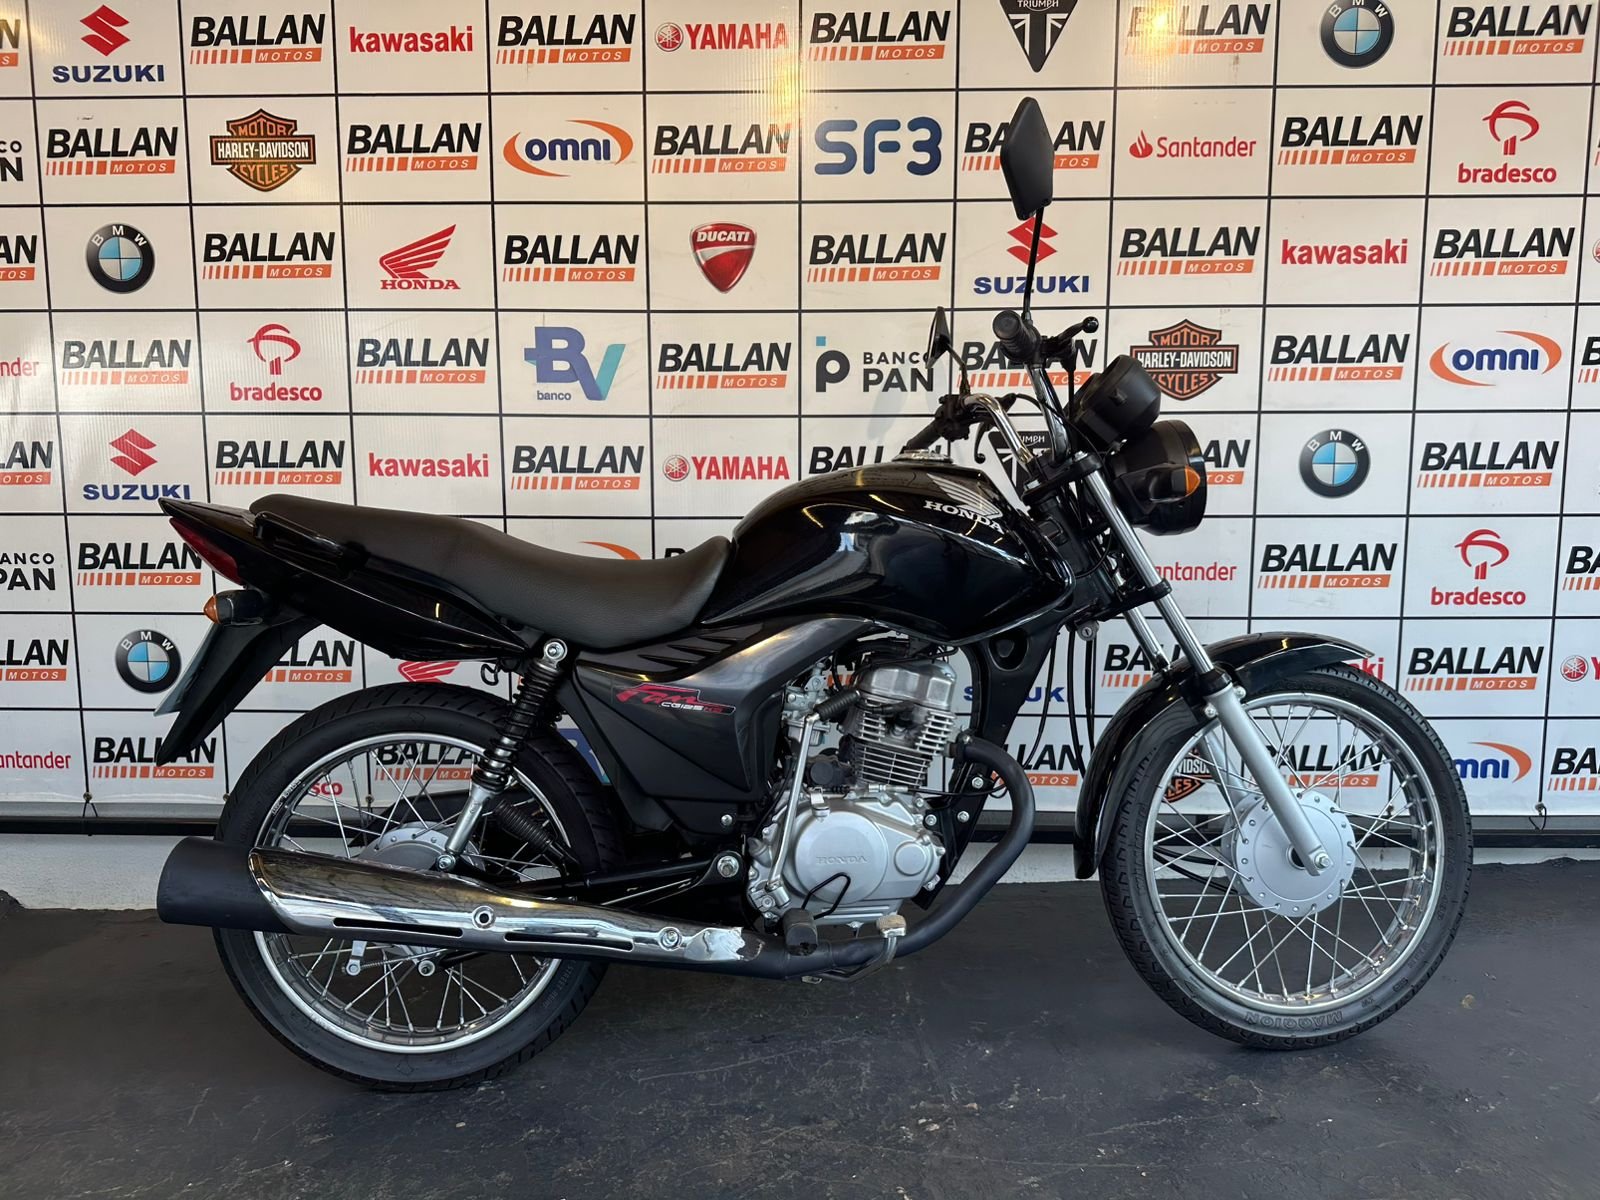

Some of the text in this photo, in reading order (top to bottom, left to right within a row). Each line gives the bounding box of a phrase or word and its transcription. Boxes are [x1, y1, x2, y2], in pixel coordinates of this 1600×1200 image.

[191, 14, 325, 46] BALLAN
[498, 14, 636, 46] BALLAN
[810, 11, 951, 43] BALLAN
[1447, 5, 1592, 37] BALLAN
[350, 26, 473, 52] kawasaki
[685, 23, 788, 50] YAMAHA
[879, 48, 935, 58] MOTOS
[1196, 42, 1255, 52] MOTOS
[1516, 42, 1574, 53] MOTOS
[259, 52, 314, 62] MOTOS
[566, 52, 622, 61] MOTOS
[53, 65, 164, 83] SUZUKI
[238, 123, 286, 136] MOTOR
[347, 123, 481, 154] BALLAN
[964, 121, 1105, 153] BAAN
[1281, 115, 1423, 147] BALLAN
[47, 127, 178, 158] BALLAN
[654, 124, 791, 155] BALLAN
[814, 117, 942, 175] SF3
[1156, 136, 1256, 158] Santander
[218, 142, 309, 158] HARLEY-DAVIDSON
[525, 138, 610, 161] omni
[1350, 152, 1407, 162] MOTOS
[113, 163, 168, 173] MOTOS
[414, 160, 469, 169] MOTOS
[721, 162, 777, 171] MOTOS
[1056, 157, 1089, 167] TOS
[240, 163, 288, 184] CYCLES
[1458, 163, 1556, 183] bradesco
[92, 224, 148, 248] BMW
[696, 231, 750, 243] DUCATI
[1120, 227, 1260, 258] BALLAN
[1434, 228, 1575, 258] BALLAN
[204, 232, 335, 262] BALLAN
[504, 235, 639, 264] BALLAN
[809, 233, 946, 264] BALLAN
[1282, 240, 1408, 265] kawasaki
[0, 271, 26, 279] TOS
[270, 268, 324, 277] MOTOS
[571, 271, 625, 280] MOTOS
[876, 269, 932, 278] MOTOS
[1188, 263, 1245, 272] MOTOS
[1501, 264, 1558, 274] MOTOS
[381, 279, 461, 290] HONDA
[1161, 330, 1210, 346] MOTOR
[64, 340, 190, 367] BALLAN
[357, 339, 489, 367] BALLAN
[659, 343, 791, 372] BALLAN
[1271, 334, 1410, 364] BALLAN
[864, 352, 930, 365] BANC
[1452, 349, 1539, 371] omni
[127, 374, 180, 383] MOTOS
[423, 373, 477, 382] MOTOS
[724, 378, 777, 387] MOTOS
[863, 368, 933, 392] PAN
[1339, 370, 1394, 379] MOTOS
[230, 382, 322, 401] bradesco
[1158, 374, 1207, 395] CYCLES
[537, 390, 571, 401] banco
[1308, 430, 1365, 453] BMW
[216, 441, 345, 468] BALLAN
[513, 446, 644, 473] BALLAN
[1421, 441, 1559, 470] BALLAN
[369, 453, 488, 477] kawasaki
[692, 456, 789, 480] YAMAHA
[3, 474, 43, 484] OTOS
[281, 474, 333, 483] MOTOS
[578, 479, 631, 488] MOTOS
[1488, 475, 1543, 485] MOTOS
[84, 485, 190, 500] SUZUKI
[924, 500, 1005, 533] HONDA
[0, 553, 55, 564] ANCO
[1261, 544, 1397, 572] BALLAN
[142, 575, 193, 584] MOTOS
[1327, 577, 1382, 586] MOTOS
[1432, 587, 1525, 606] bradesco
[121, 631, 174, 651] BMW
[1408, 647, 1544, 675] BALLAN
[8, 670, 58, 680] MOTOS
[292, 671, 344, 682] MOTOS
[1474, 679, 1528, 689] MOTOS
[661, 702, 704, 711] CG125
[0, 751, 71, 769] antander
[1455, 759, 1508, 779] mni
[156, 767, 207, 777] MOTOS
[816, 856, 868, 864] HONDA
